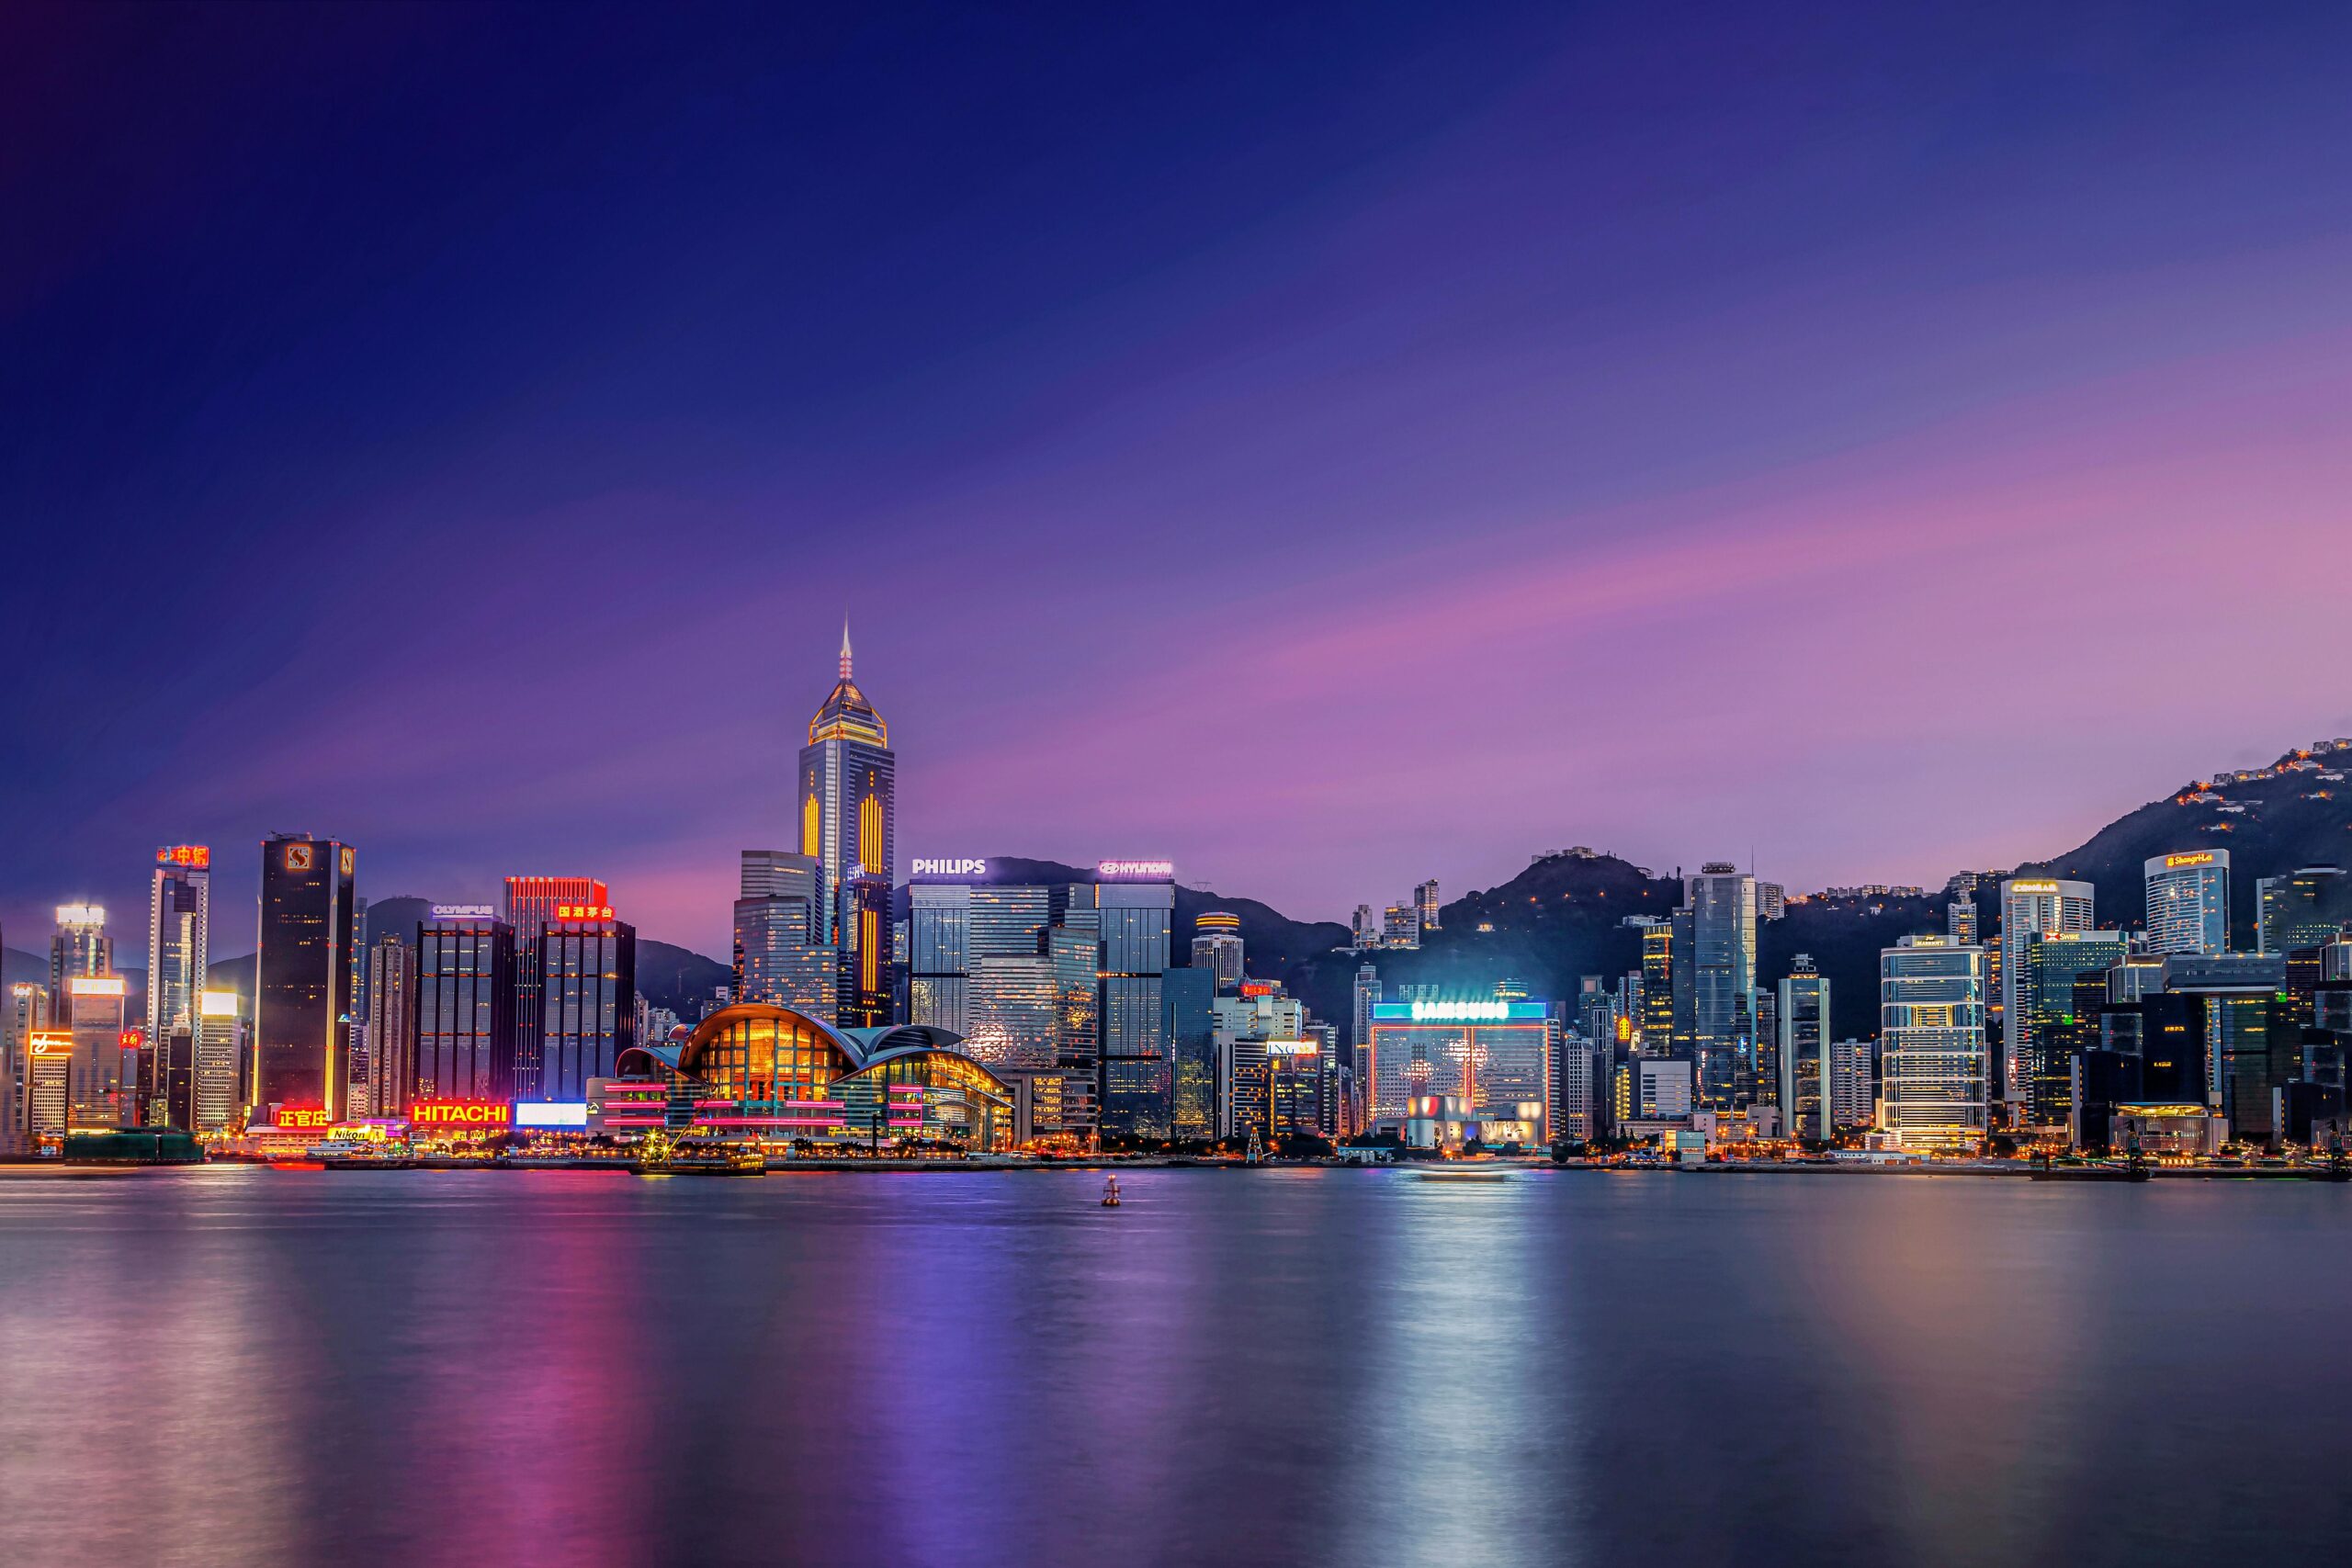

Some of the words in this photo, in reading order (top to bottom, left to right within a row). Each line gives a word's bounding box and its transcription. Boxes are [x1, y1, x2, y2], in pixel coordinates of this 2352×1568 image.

[912, 859, 986, 874] PHILIPS
[1119, 863, 1171, 874] HYUNDAI
[433, 905, 493, 915] OLYMPUS
[559, 906, 612, 918] 国酒茅台
[1411, 1001, 1509, 1020] SAMSUNG
[278, 1110, 328, 1126] 正官庄
[414, 1106, 506, 1122] HITACHI
[334, 1130, 365, 1139] Nikon
